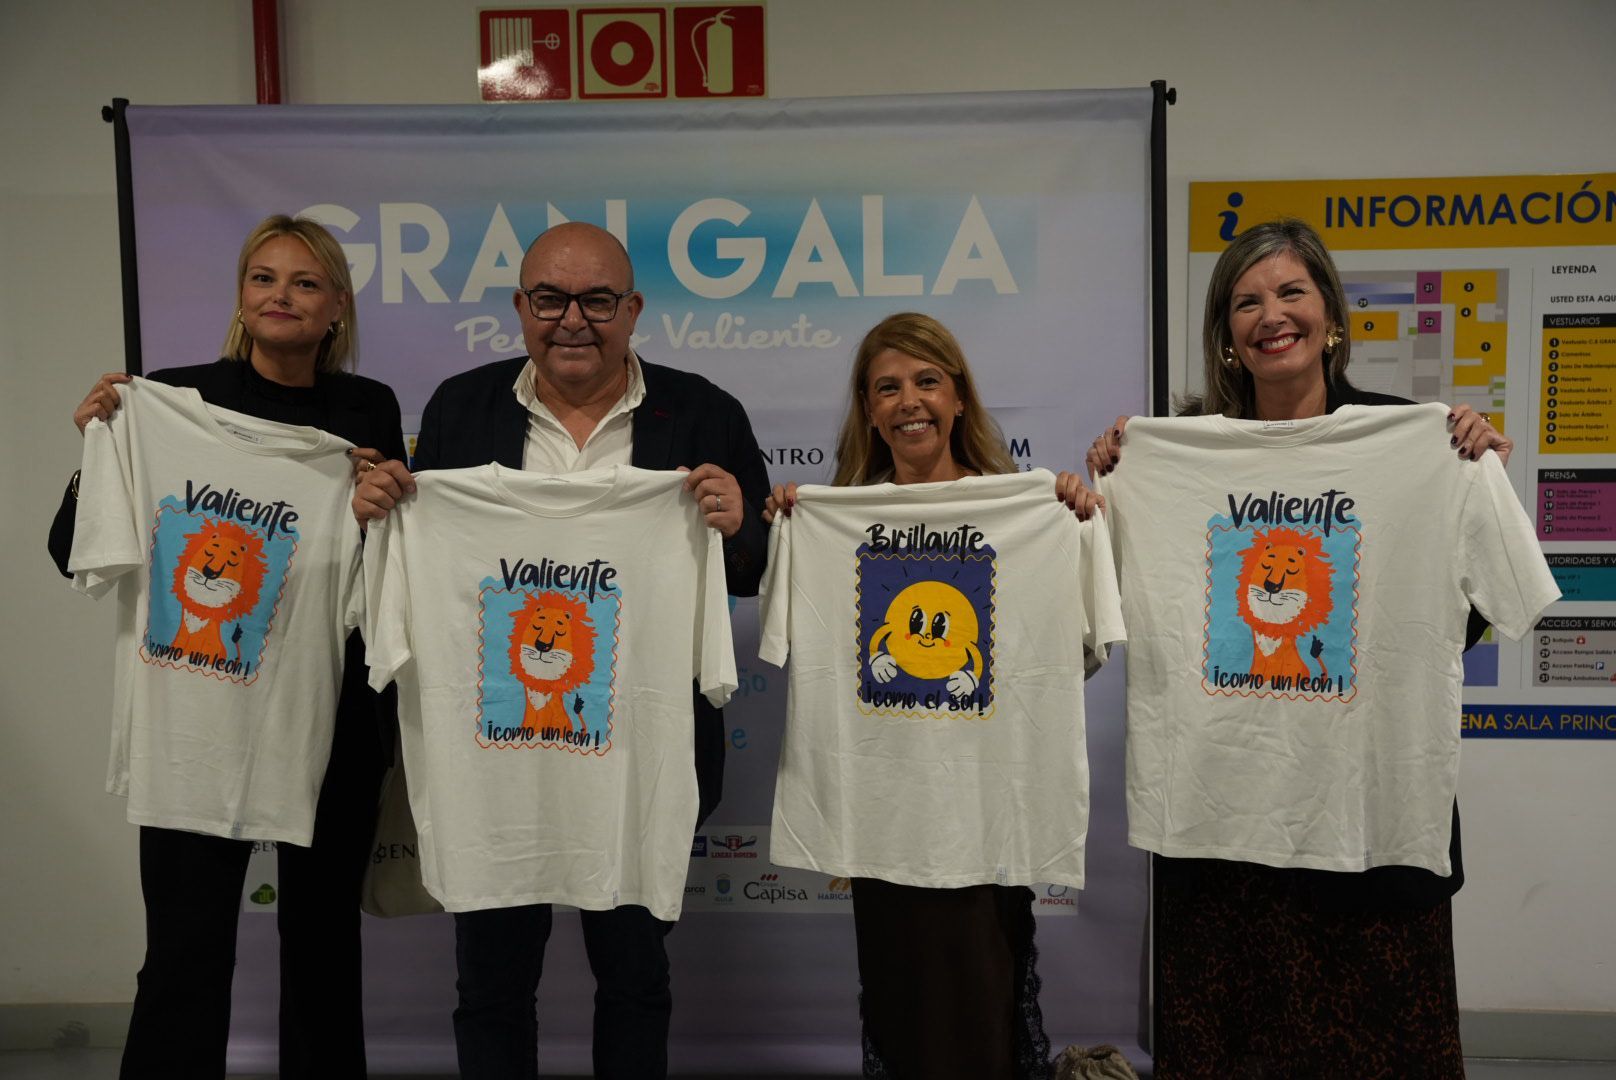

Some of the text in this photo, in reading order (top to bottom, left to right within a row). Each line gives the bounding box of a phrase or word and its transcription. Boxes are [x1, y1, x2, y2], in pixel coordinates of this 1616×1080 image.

[667, 194, 1019, 299] GALA
[1551, 265, 1597, 274] LEYENDA
[1549, 316, 1600, 326] VESTUARIOS
[661, 311, 841, 350] Valiente
[1544, 471, 1577, 480] PRENSA
[186, 480, 299, 541] Valiente
[1228, 488, 1355, 538] Valiente
[866, 522, 985, 564] Brillante
[1548, 556, 1601, 565] UTORIDADES
[1603, 556, 1608, 564] Y
[500, 558, 617, 604] Valiente
[1540, 619, 1582, 628] ACCESOS
[1584, 619, 1589, 628] Y
[188, 650, 210, 667] un
[1271, 674, 1292, 691] un
[925, 690, 940, 710] el
[1503, 713, 1553, 730] SALA
[542, 726, 560, 742] un
[744, 882, 808, 904] Capisa
